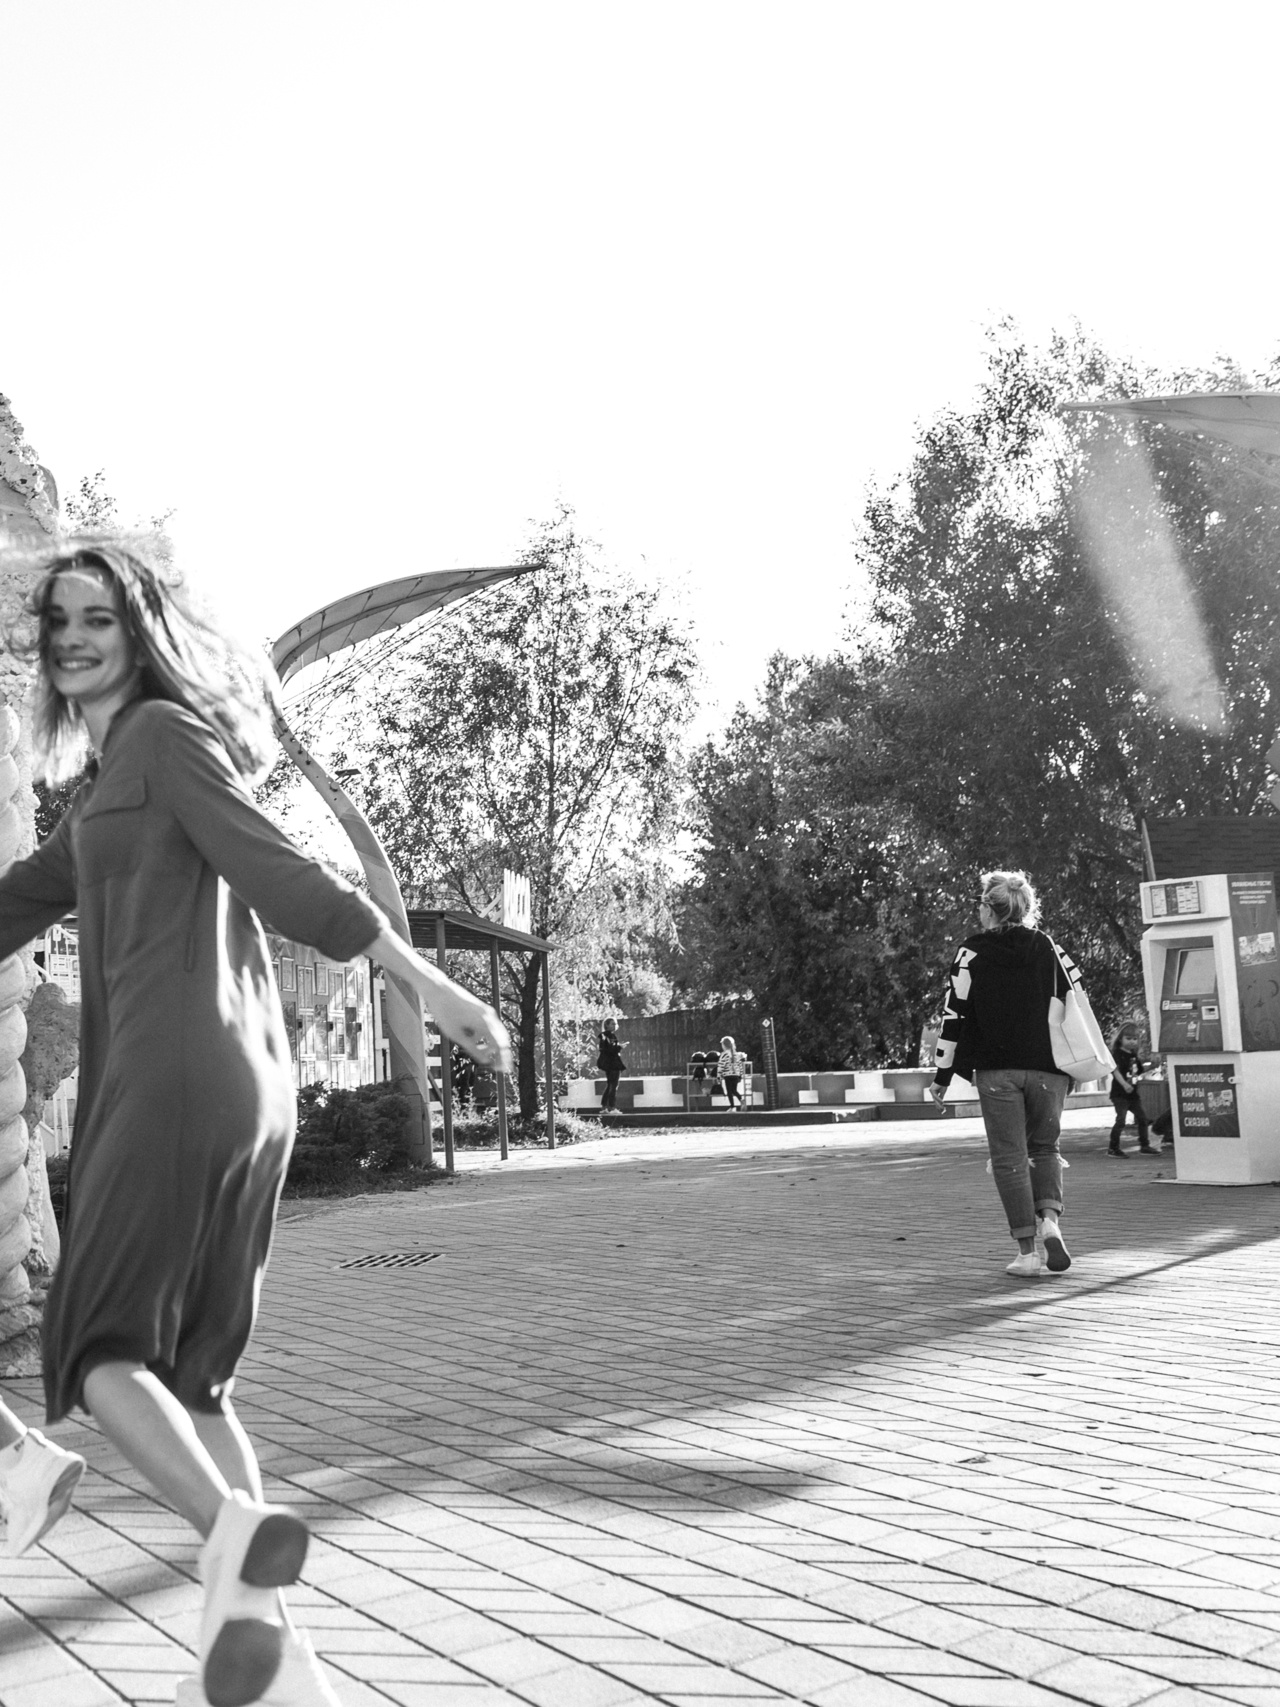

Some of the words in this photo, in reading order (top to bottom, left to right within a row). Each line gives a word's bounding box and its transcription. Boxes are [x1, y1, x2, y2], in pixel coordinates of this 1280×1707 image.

[1180, 1072, 1224, 1083] ПОПОЛНЕНИЕ
[1181, 1087, 1205, 1098] КАРТЫ
[1182, 1102, 1205, 1112] ПАРКА
[1184, 1116, 1210, 1127] СКАЗКА
